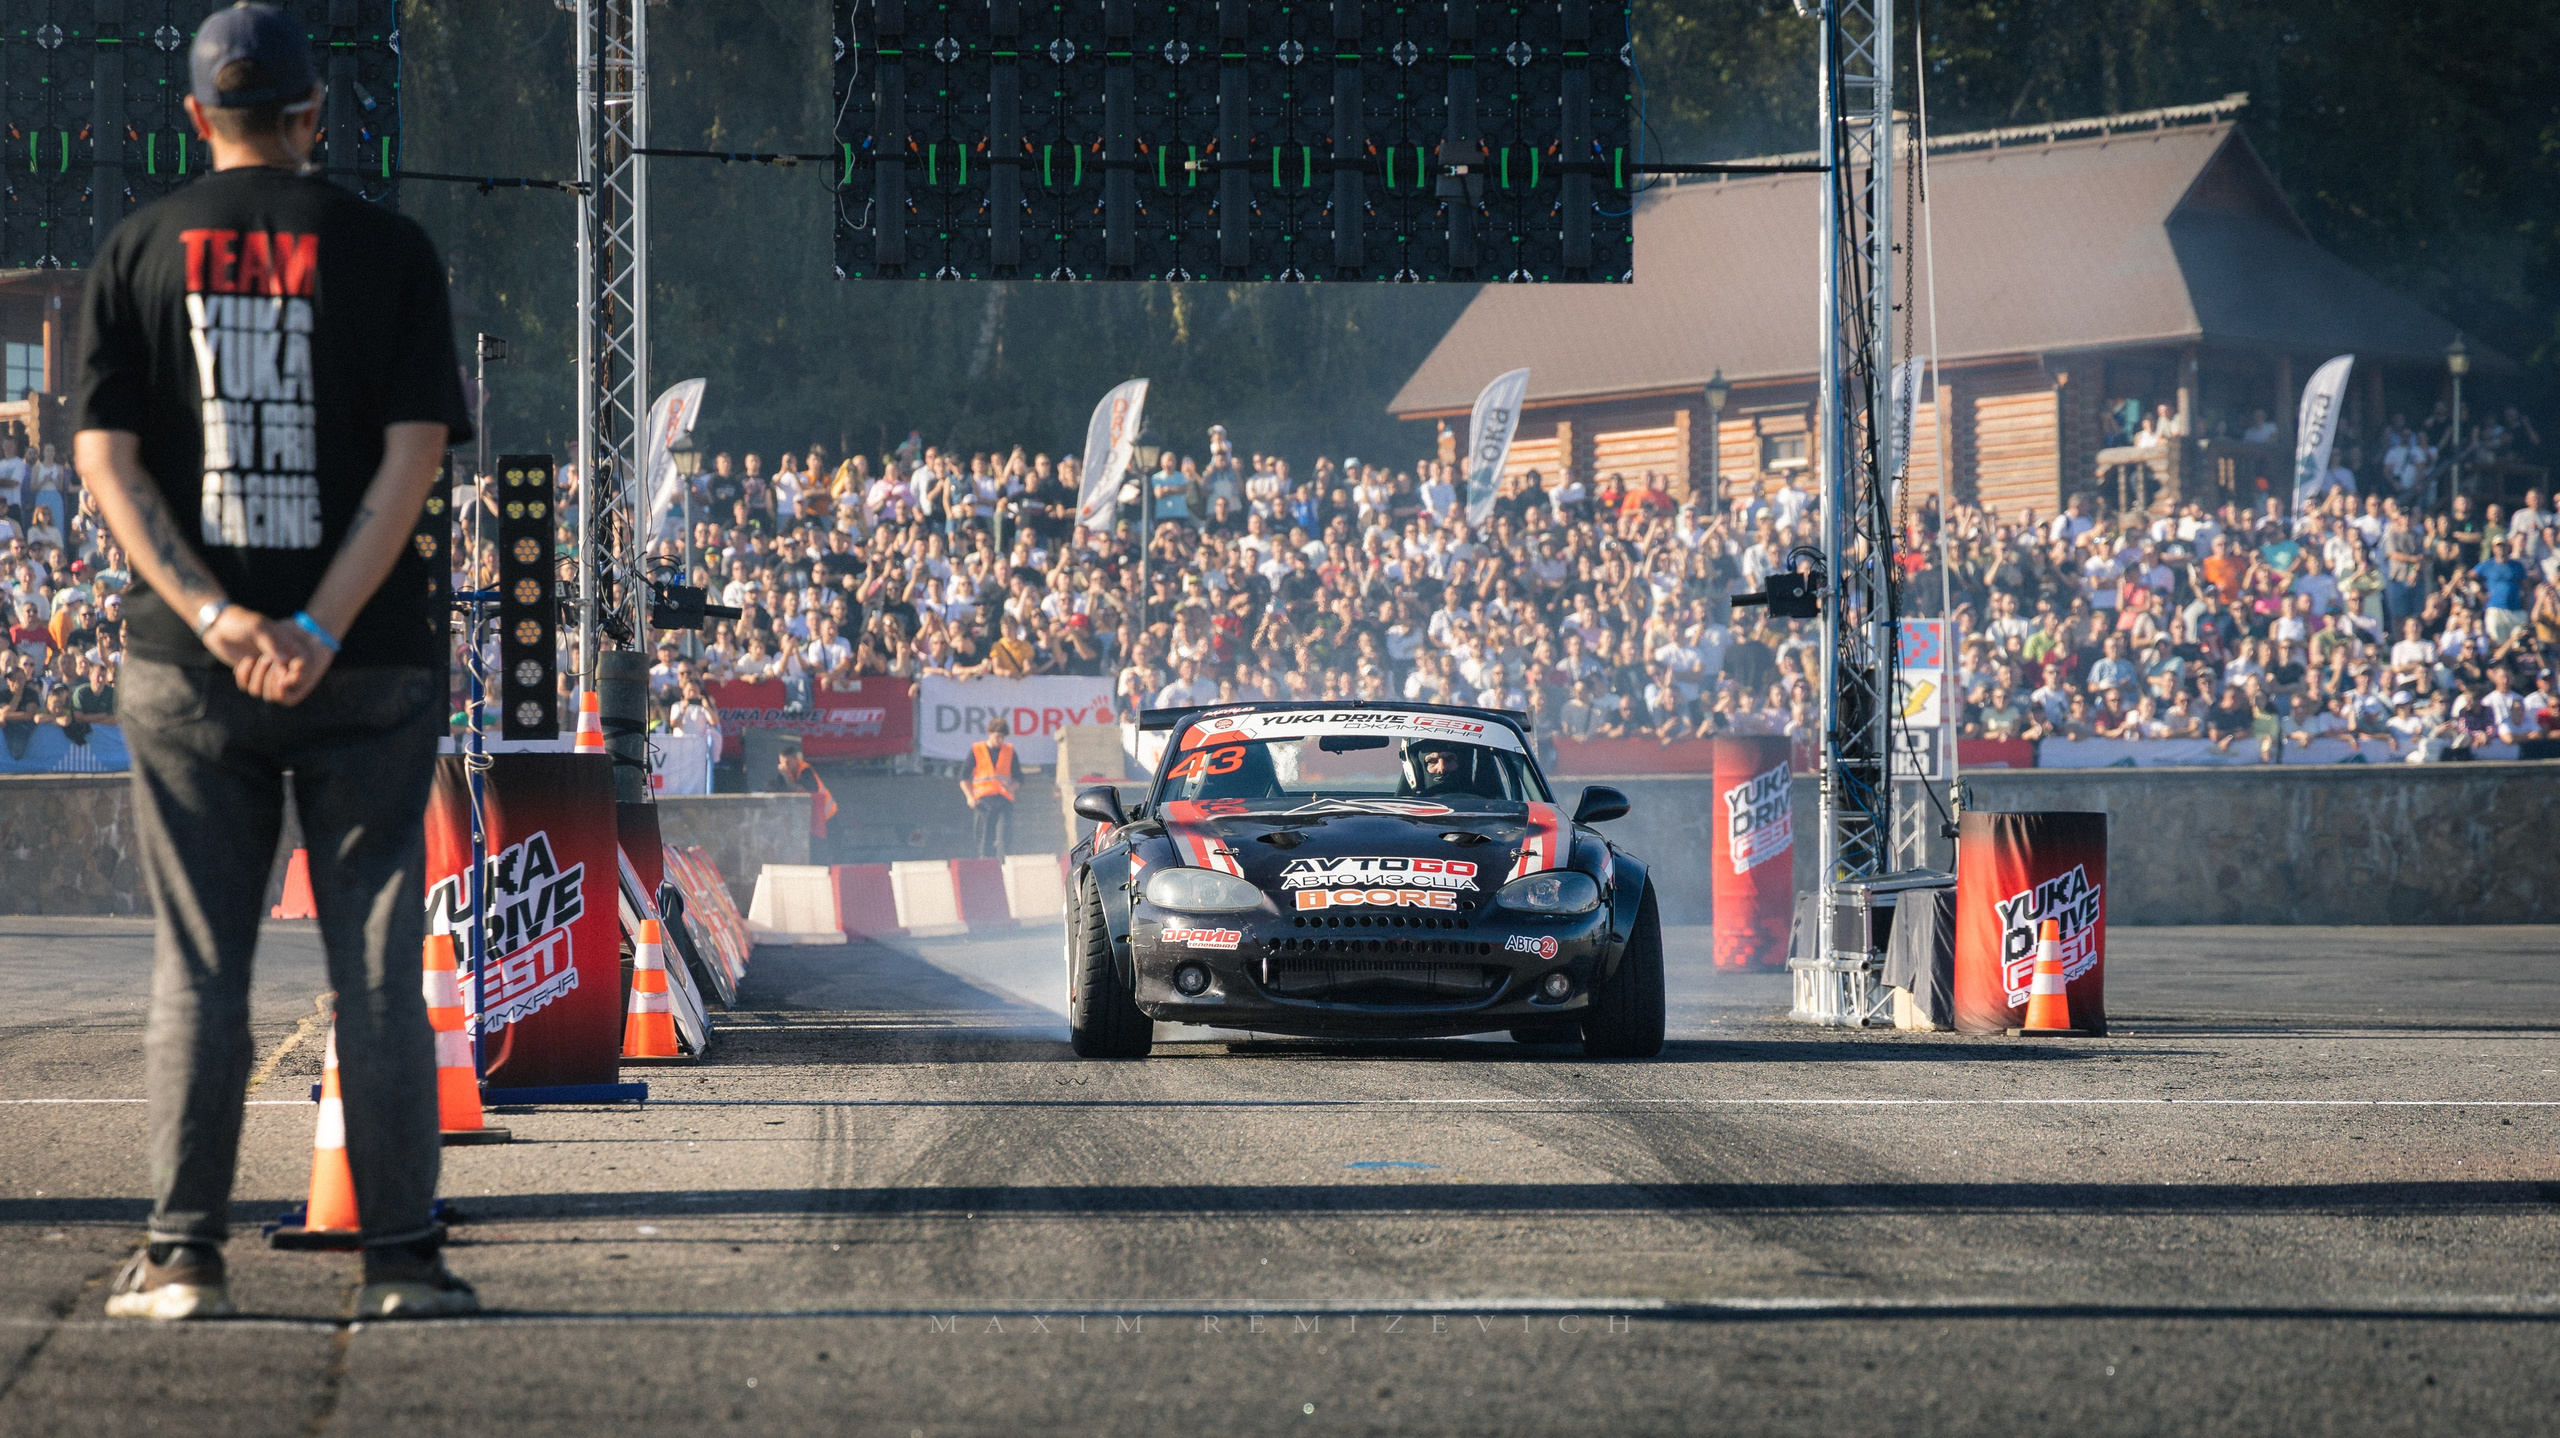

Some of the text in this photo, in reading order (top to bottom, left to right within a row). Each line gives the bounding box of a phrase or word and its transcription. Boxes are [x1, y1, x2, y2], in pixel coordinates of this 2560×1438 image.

[179, 229, 319, 296] TEAM
[1110, 398, 1128, 448] DRY
[201, 471, 323, 548] RACING
[1262, 713, 1484, 732] YUKA DRIVE FEST
[1343, 723, 1482, 738] ДЖИМХАНА
[1167, 745, 1246, 780] 43
[1729, 764, 1790, 812] YUKA
[1283, 857, 1476, 877] AVTOGO
[1284, 874, 1476, 891] АВТО ИЗ США
[450, 866, 582, 974] RIVE
[2000, 867, 2088, 931] YUKA
[1162, 928, 1241, 943] ДРАЙВ
[2009, 928, 2092, 991] FST
[457, 930, 566, 1017] EST
